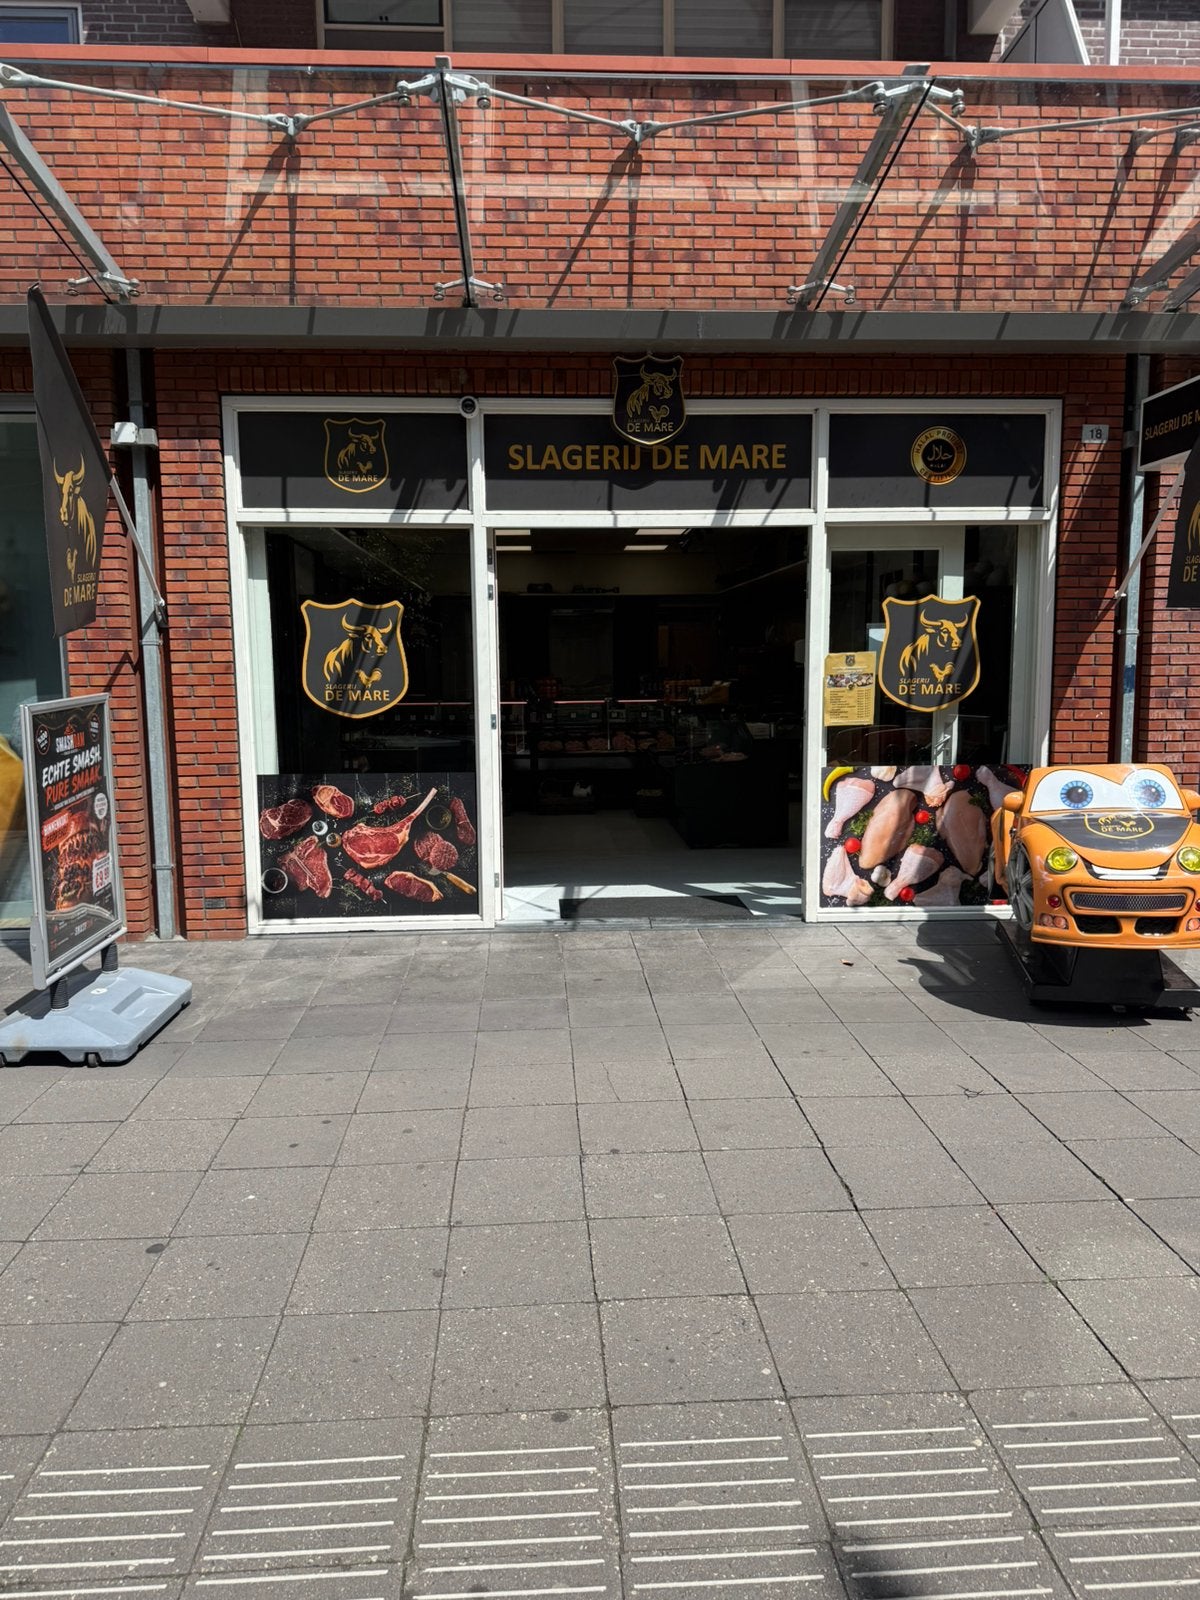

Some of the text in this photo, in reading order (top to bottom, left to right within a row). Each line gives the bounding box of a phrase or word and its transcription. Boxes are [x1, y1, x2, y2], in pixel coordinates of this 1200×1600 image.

[627, 422, 674, 432] DE MARE
[1145, 416, 1181, 440] SLAGERIJ
[1182, 411, 1194, 428] DE
[1090, 428, 1102, 440] 18
[508, 444, 787, 470] SLAGERIJ DE MARE
[338, 474, 378, 482] DE MARE
[1183, 566, 1198, 582] DE
[64, 583, 96, 608] DE MARE
[325, 690, 390, 701] DE MARE
[898, 683, 961, 695] DE MARE
[42, 744, 102, 788] ECHTE SMASH.
[46, 779, 70, 807] PURE
